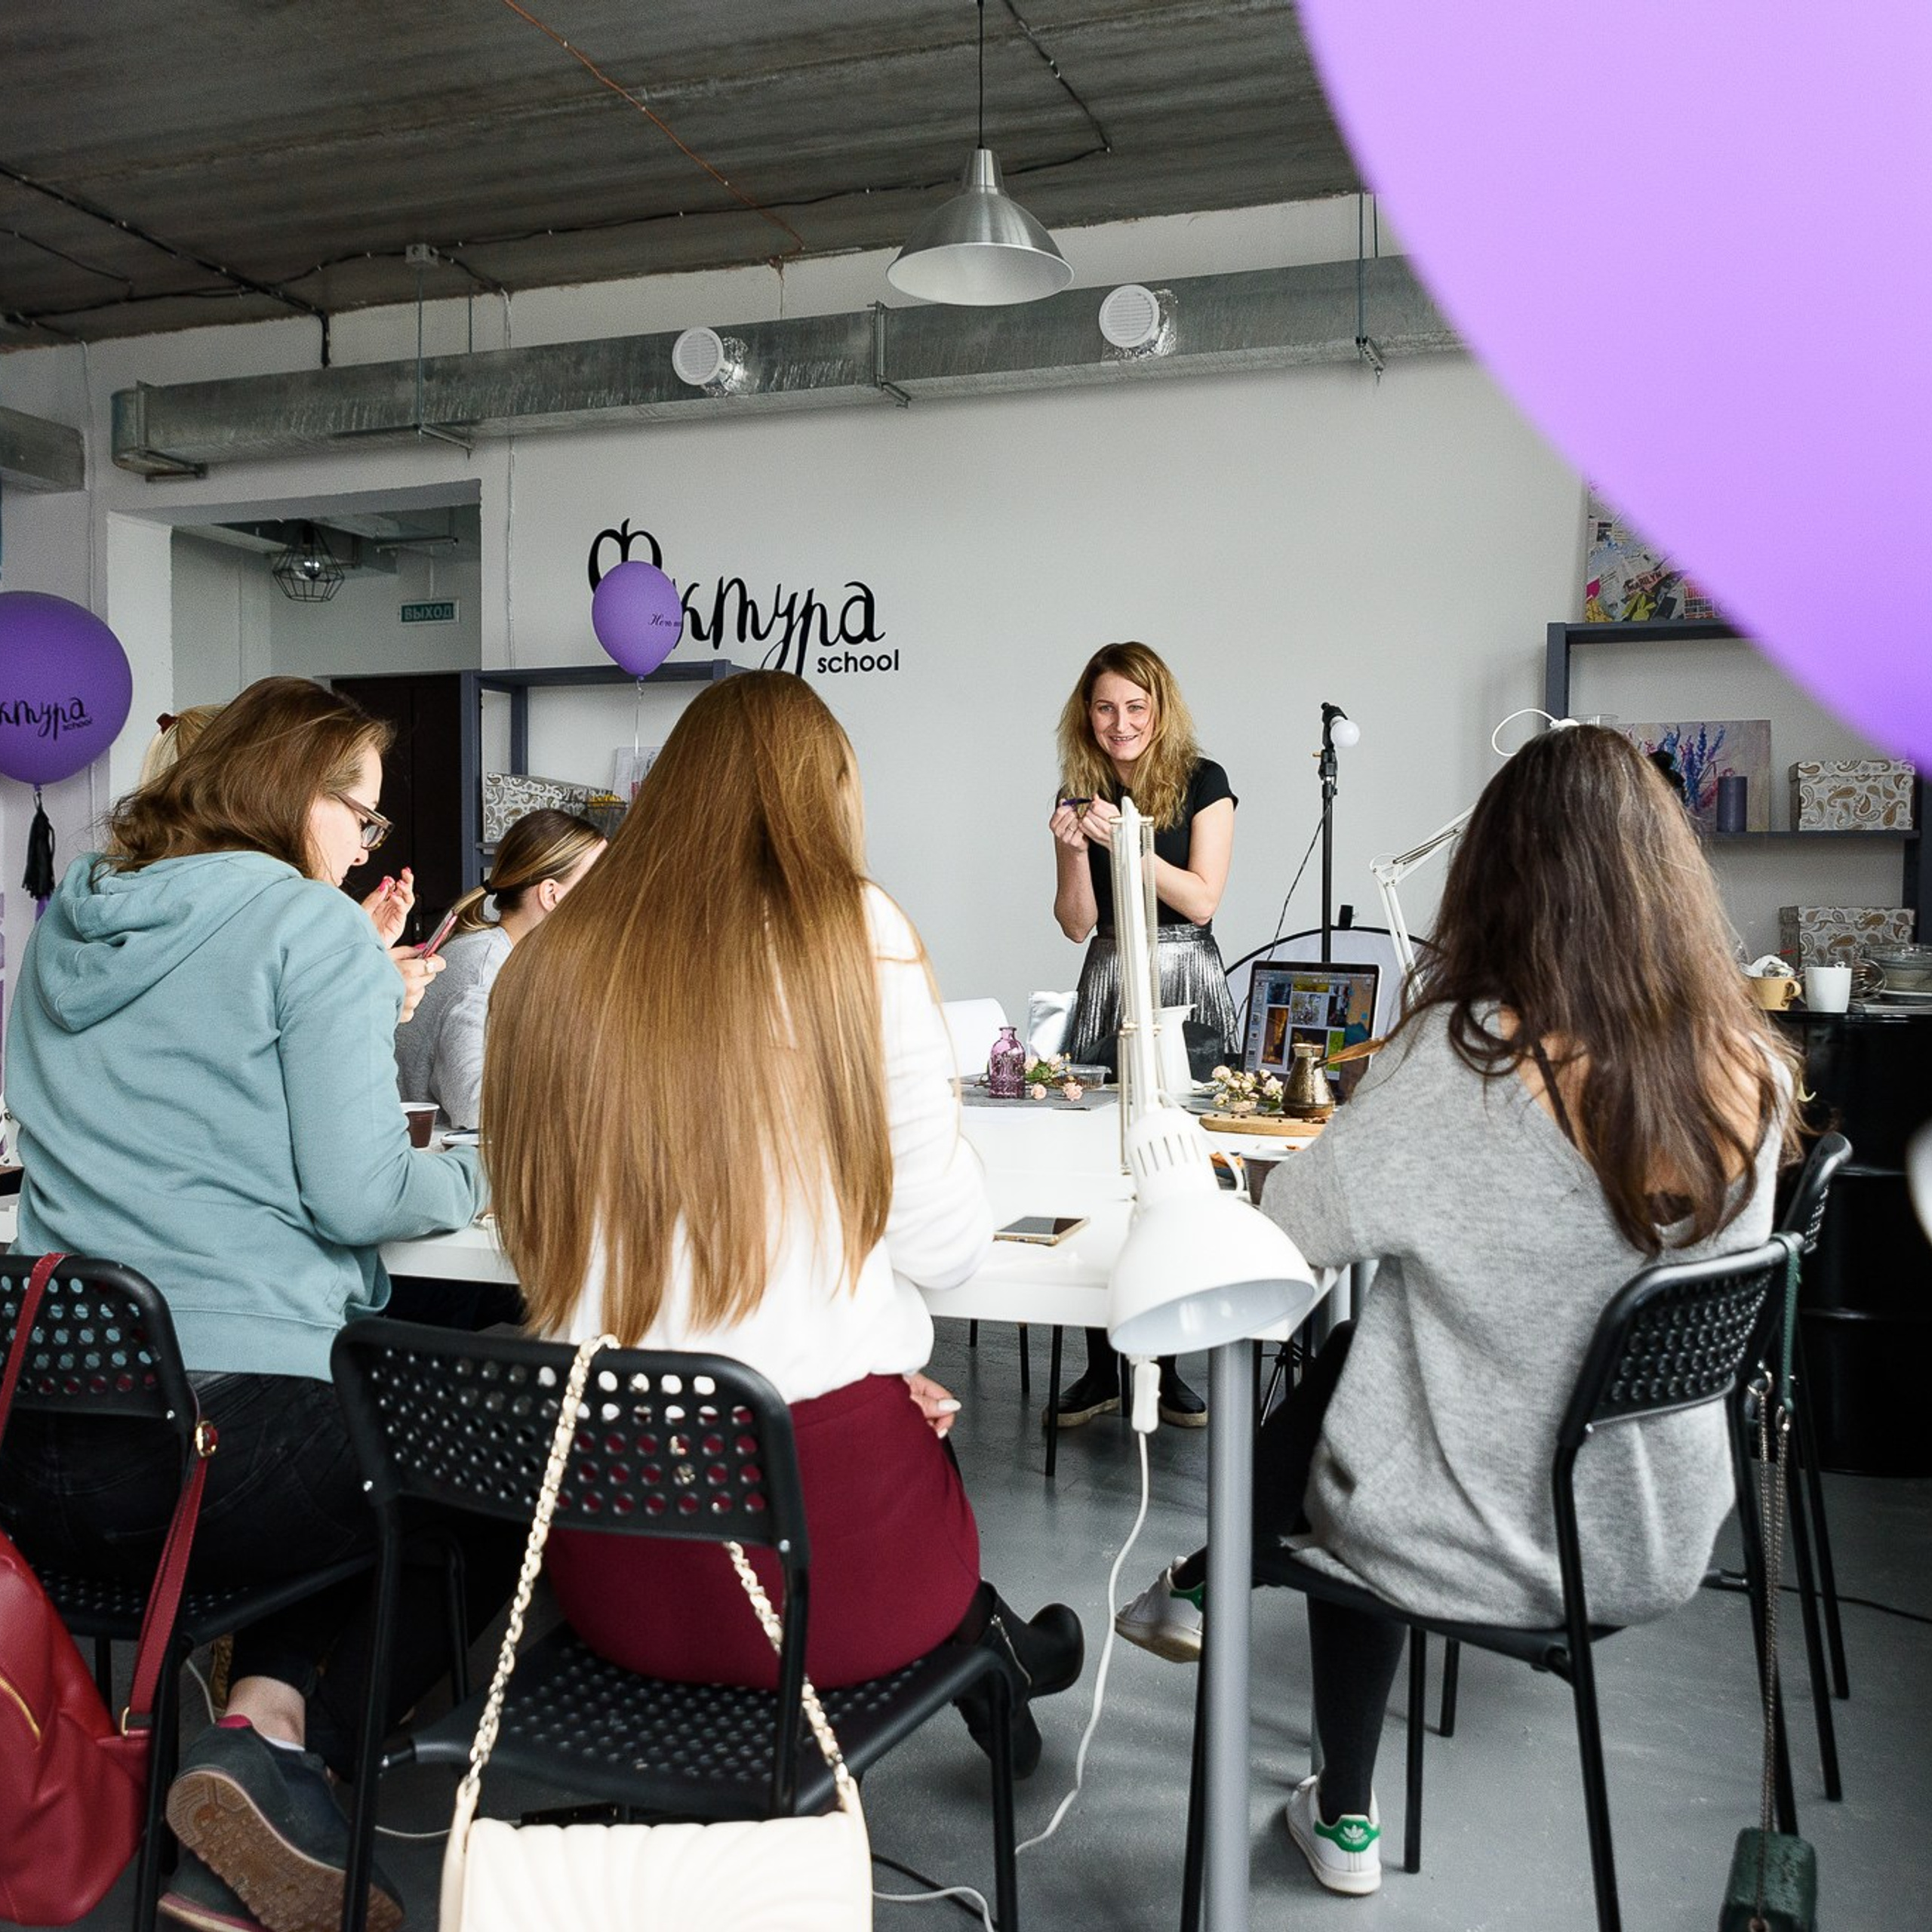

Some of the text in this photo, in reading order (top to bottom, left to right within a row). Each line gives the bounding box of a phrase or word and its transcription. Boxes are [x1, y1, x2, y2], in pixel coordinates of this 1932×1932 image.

[404, 605, 452, 620] ВЫХОД
[817, 649, 900, 674] school
[63, 717, 93, 731] school
